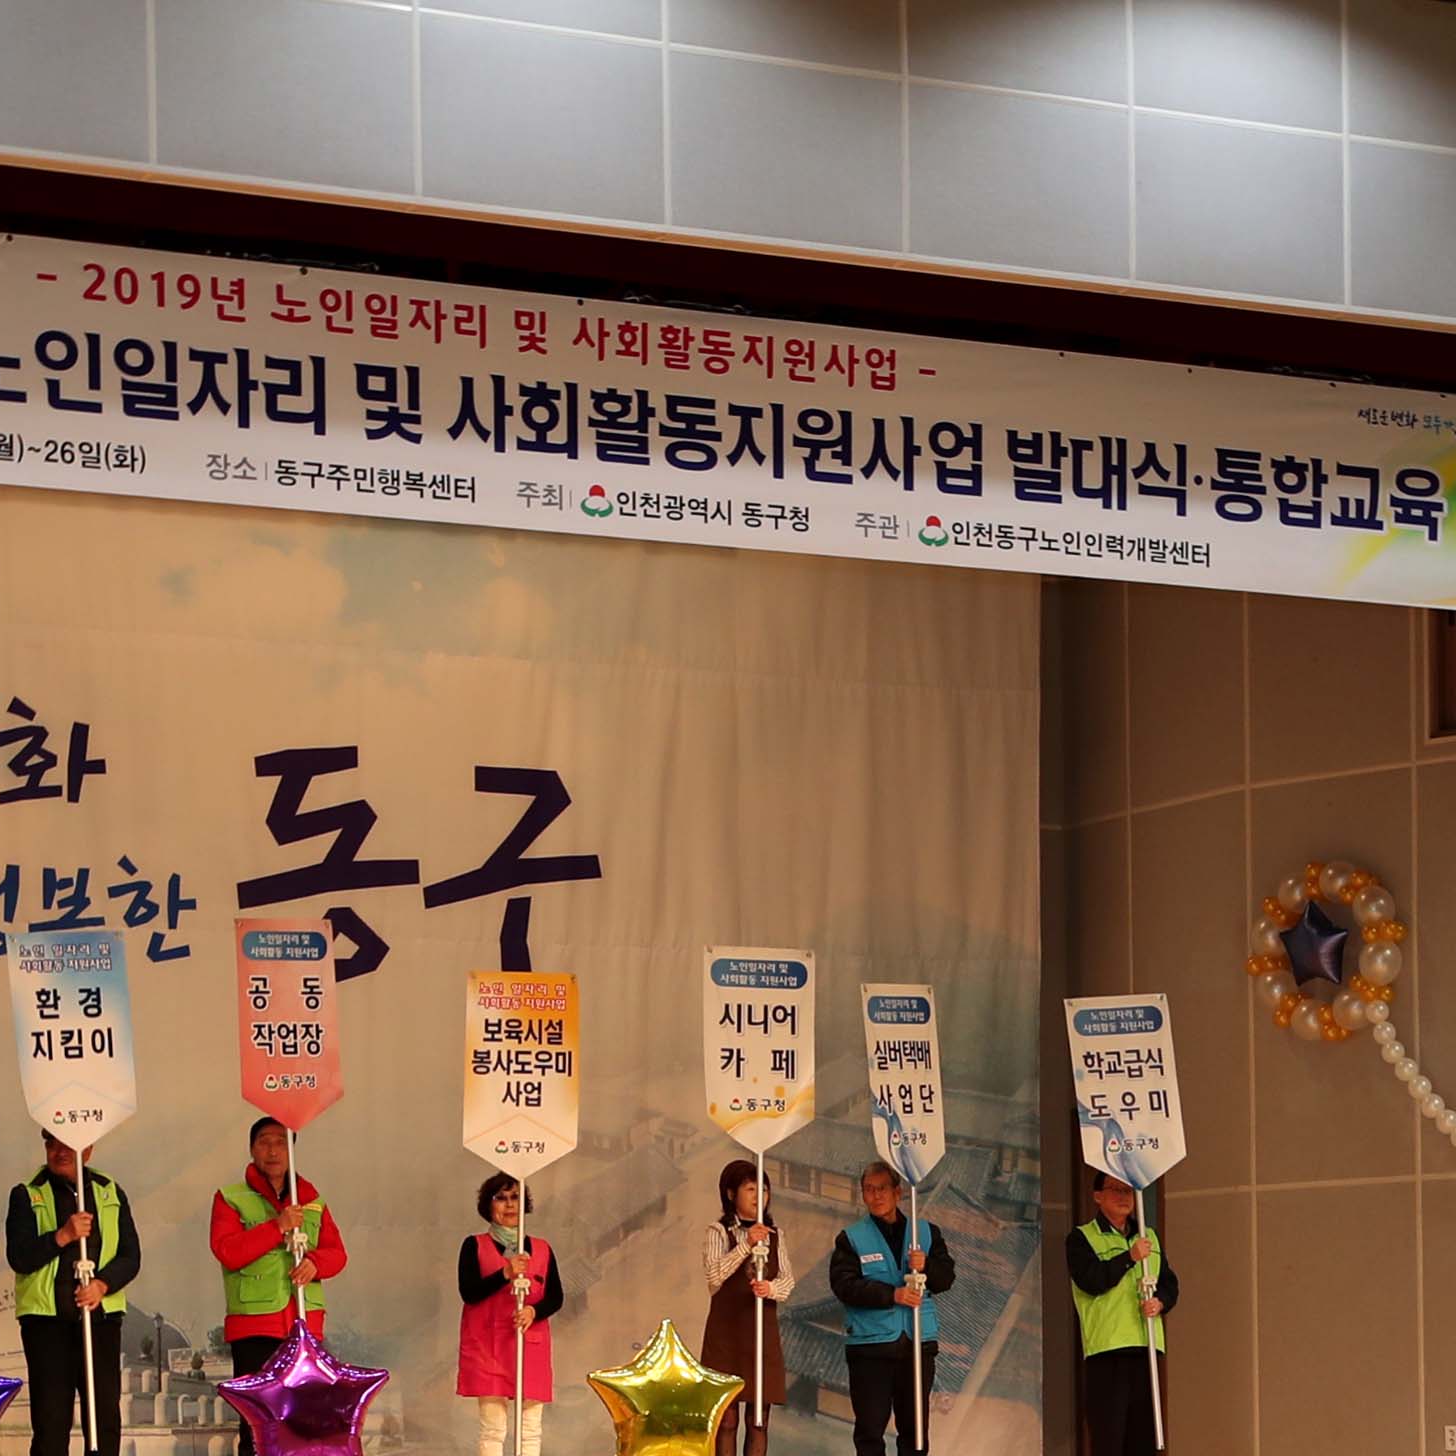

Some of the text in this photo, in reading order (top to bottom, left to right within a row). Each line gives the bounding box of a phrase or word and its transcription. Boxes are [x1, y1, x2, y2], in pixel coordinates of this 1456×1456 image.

[81, 262, 247, 324] 2019년
[270, 281, 490, 350] 노인일자리
[513, 309, 549, 355] 및
[572, 316, 898, 393] 사회활동지원사업
[353, 362, 424, 446] 및
[447, 373, 984, 499] 사회활동지원사업
[1006, 428, 1444, 542] 발대식·통합교육
[205, 453, 477, 504] 장소 동구주민행복센터
[516, 482, 811, 533] 주최 인천광역시 동구청
[855, 512, 1212, 569] 주관 인천동구노인인력개발센터
[236, 744, 604, 985] 동구
[35, 987, 103, 1020] 환경
[248, 977, 323, 1009] 공동
[483, 1018, 563, 1045] 보육시설
[719, 1004, 796, 1035] 시니어
[31, 1027, 114, 1061] 지킴이
[253, 1024, 323, 1055] 작업장
[874, 1040, 931, 1070] 실버택배
[472, 1049, 572, 1077] 봉사도우미
[720, 1048, 795, 1080] 카페
[1083, 1048, 1164, 1079] 학교급식
[281, 1075, 317, 1088] 동구청
[502, 1081, 542, 1107] 사업
[746, 1098, 785, 1112] 동구청
[879, 1084, 934, 1114] 사업단
[1090, 1089, 1169, 1120] 도우미
[67, 1109, 103, 1123] 동구청
[511, 1141, 545, 1154] 동구청
[902, 1133, 927, 1145] 동구청
[1123, 1138, 1159, 1150] 동구청
